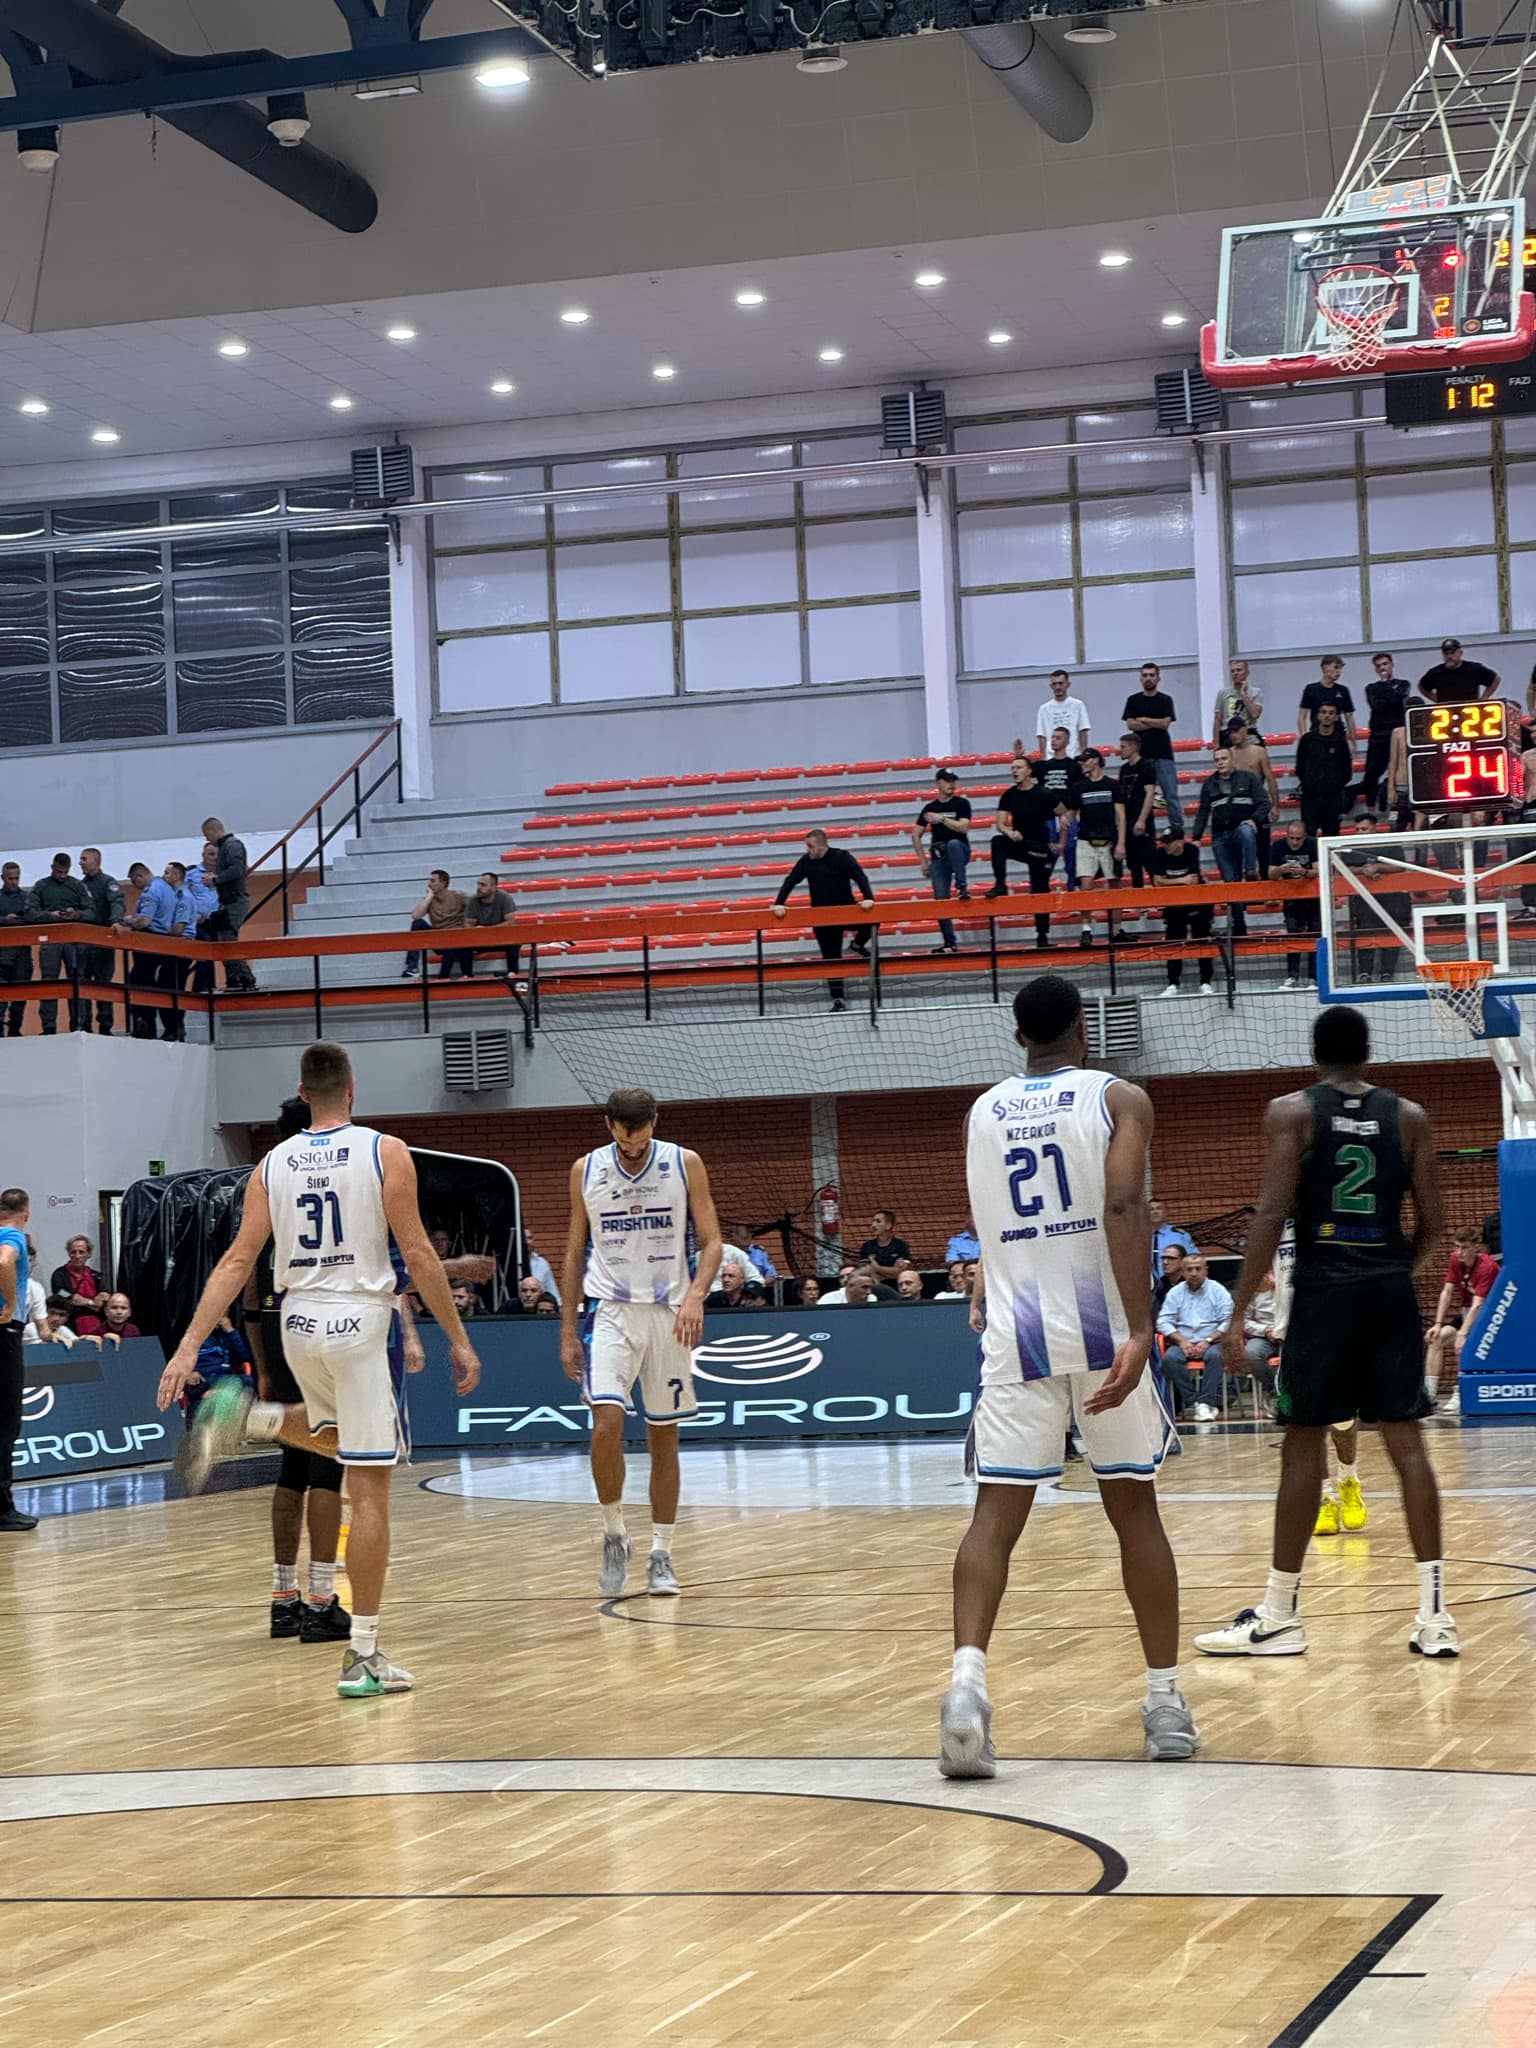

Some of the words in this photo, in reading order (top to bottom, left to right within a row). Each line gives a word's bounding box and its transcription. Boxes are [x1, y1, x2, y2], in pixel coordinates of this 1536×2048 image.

[1434, 296, 1450, 316] 2
[1508, 376, 1532, 386] FAZI
[1431, 704, 1502, 740] 2:22
[1442, 741, 1471, 753] FAZI
[1446, 754, 1505, 798] 24
[1008, 1094, 1057, 1112] SIGAL
[299, 1150, 337, 1164] SIGAL
[1005, 1143, 1073, 1217] 21
[1331, 1144, 1377, 1214] 2
[297, 1191, 344, 1250] 31
[601, 1215, 673, 1233] PRISHTINA
[1044, 1218, 1097, 1234] NEPTUN
[326, 1318, 361, 1335] LUX
[1474, 1281, 1518, 1361] HYDROPLAY
[668, 1379, 684, 1410] 7
[1478, 1384, 1536, 1398] SPORT
[677, 1392, 973, 1427] GROU
